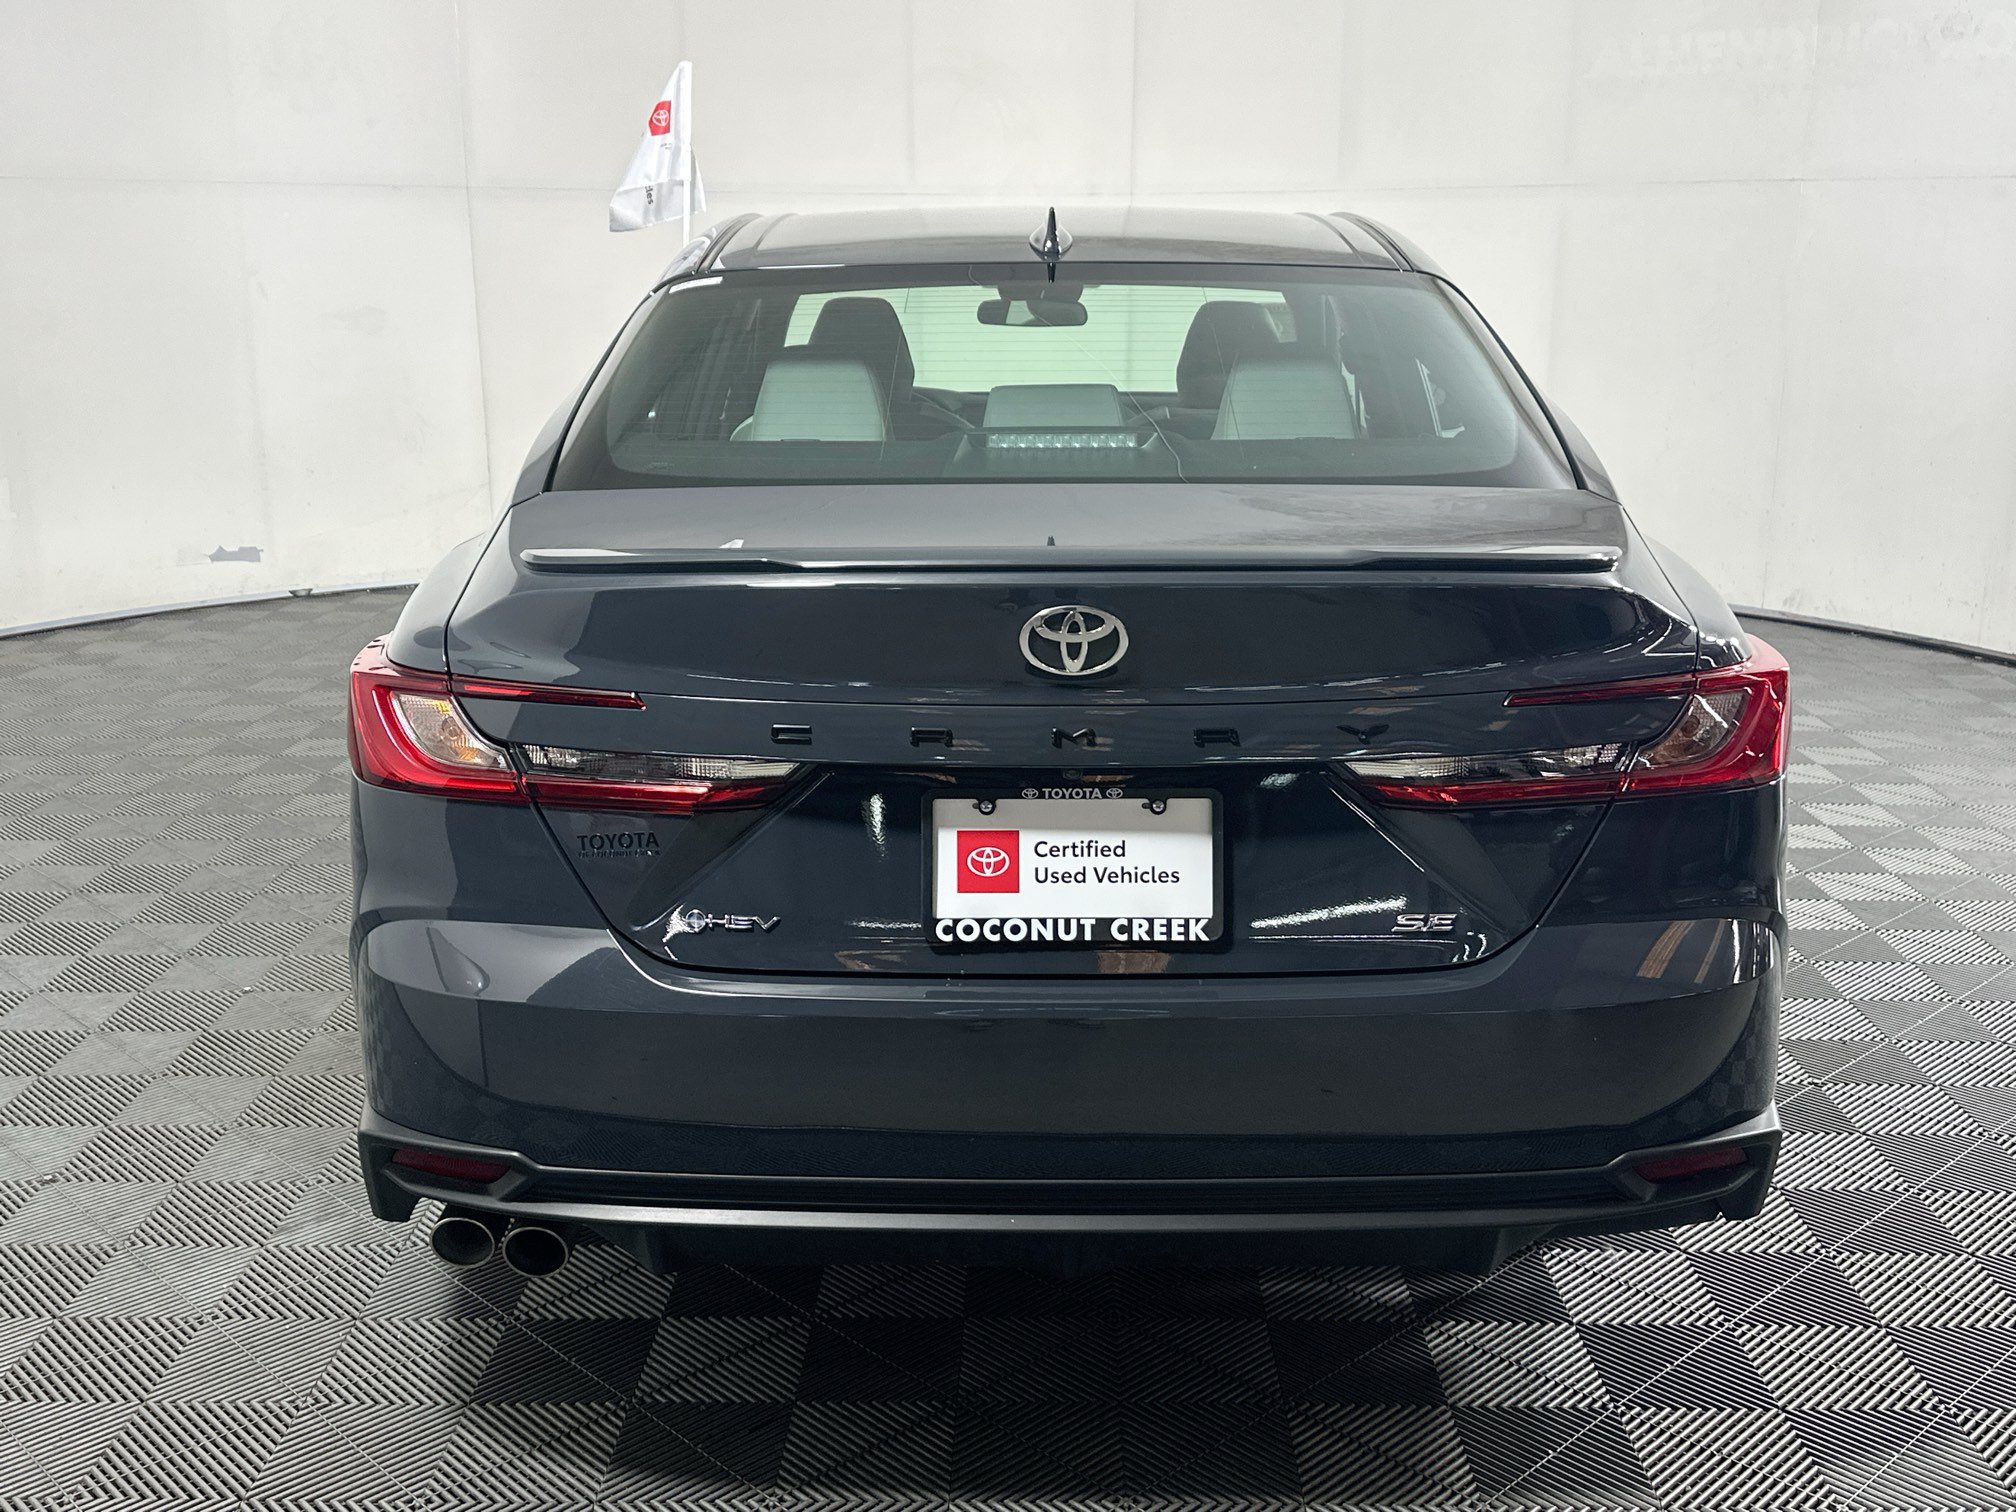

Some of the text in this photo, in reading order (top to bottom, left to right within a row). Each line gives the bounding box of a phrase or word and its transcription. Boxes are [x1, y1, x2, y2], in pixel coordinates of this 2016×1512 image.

[771, 723, 1390, 748] CAMRY
[1042, 788, 1103, 800] TOYOTA
[576, 832, 660, 851] TOYOTA
[1034, 840, 1126, 858] Certified
[1034, 867, 1180, 884] Used Vehicles
[707, 913, 781, 932] HEV
[935, 918, 1211, 942] COCONUT CREEK
[1391, 913, 1457, 932] SE
